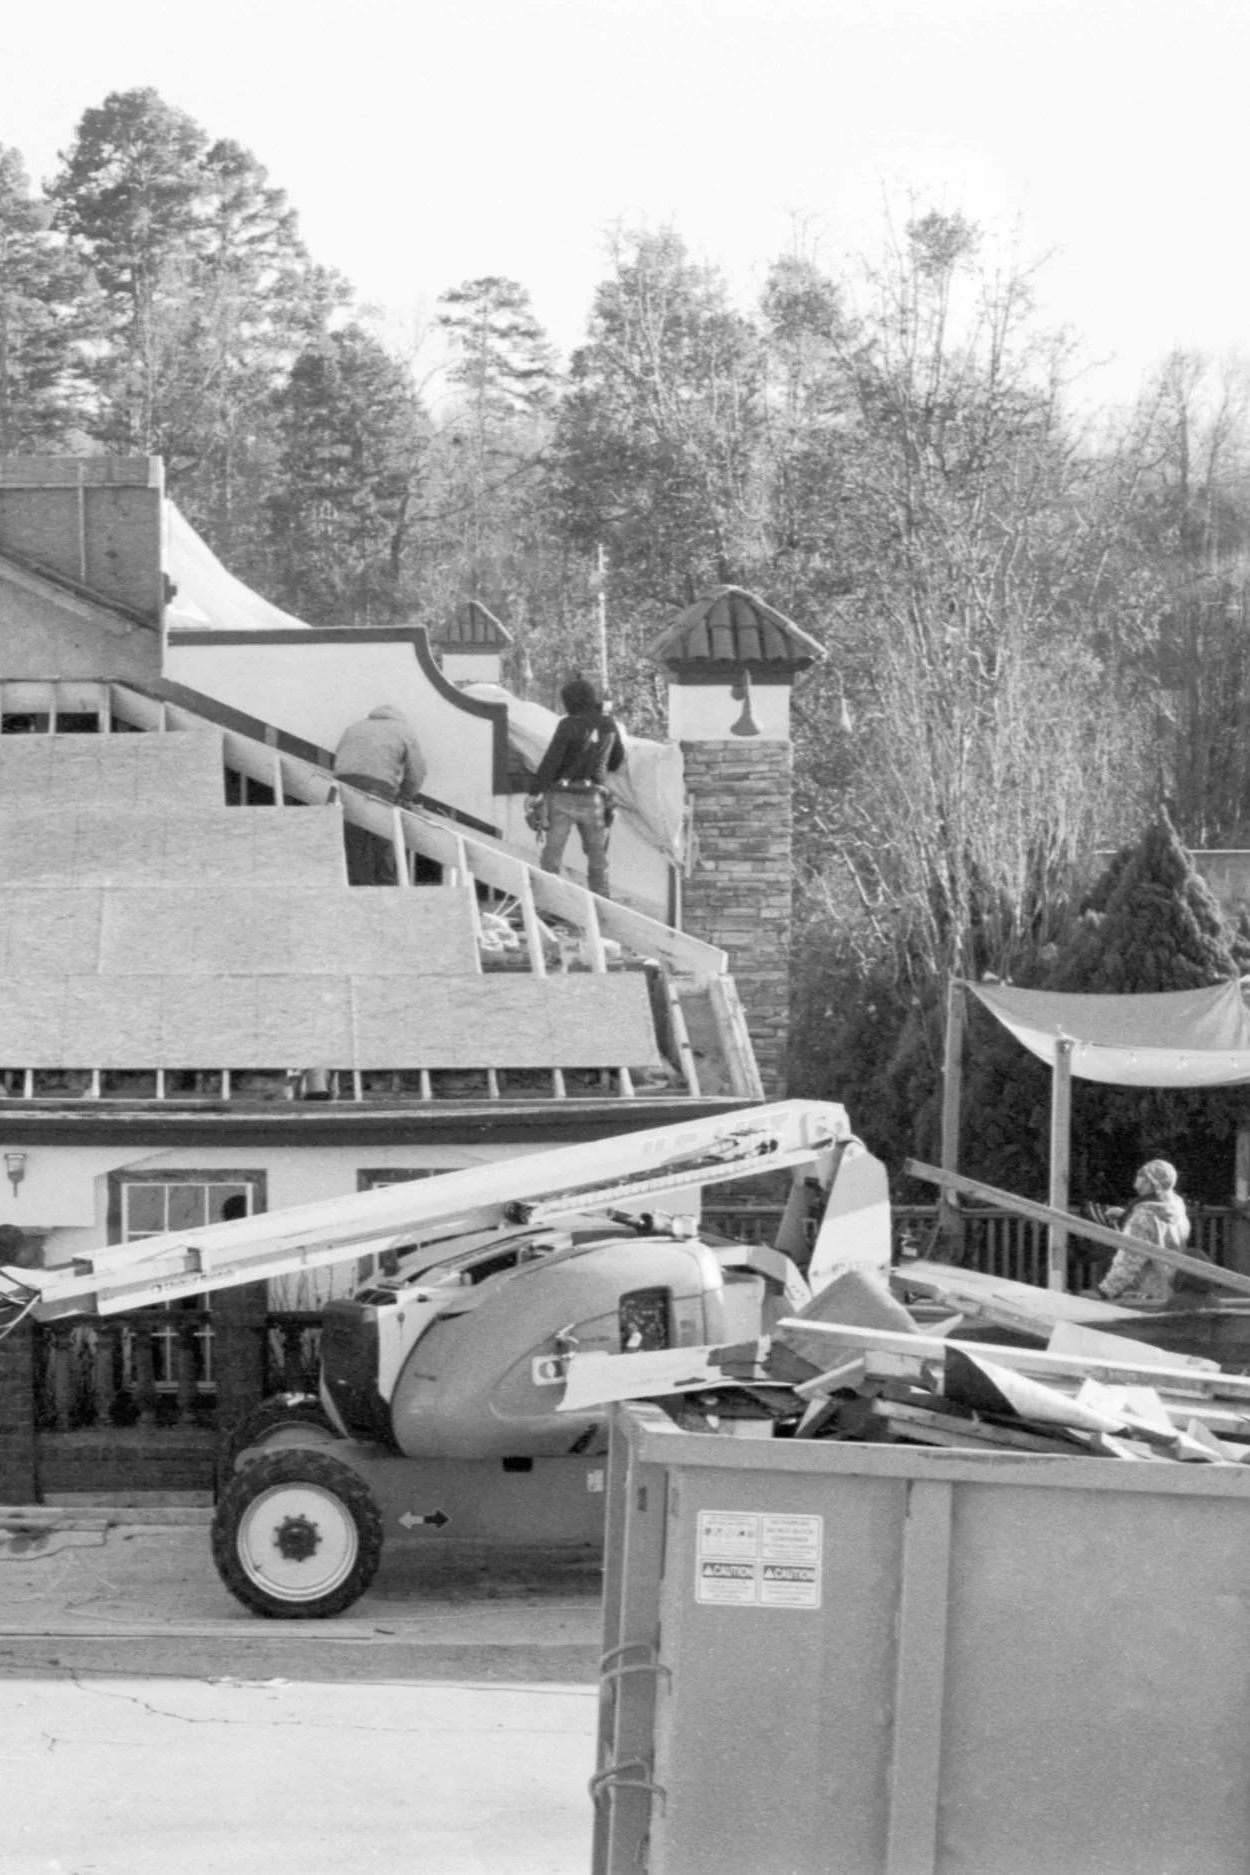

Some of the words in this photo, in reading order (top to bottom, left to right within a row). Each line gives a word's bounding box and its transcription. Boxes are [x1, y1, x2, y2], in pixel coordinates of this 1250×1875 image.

[165, 1276, 198, 1290] United
[200, 1269, 235, 1281] Rentals
[714, 1565, 753, 1577] CAUTION
[774, 1568, 814, 1580] CAUTION
